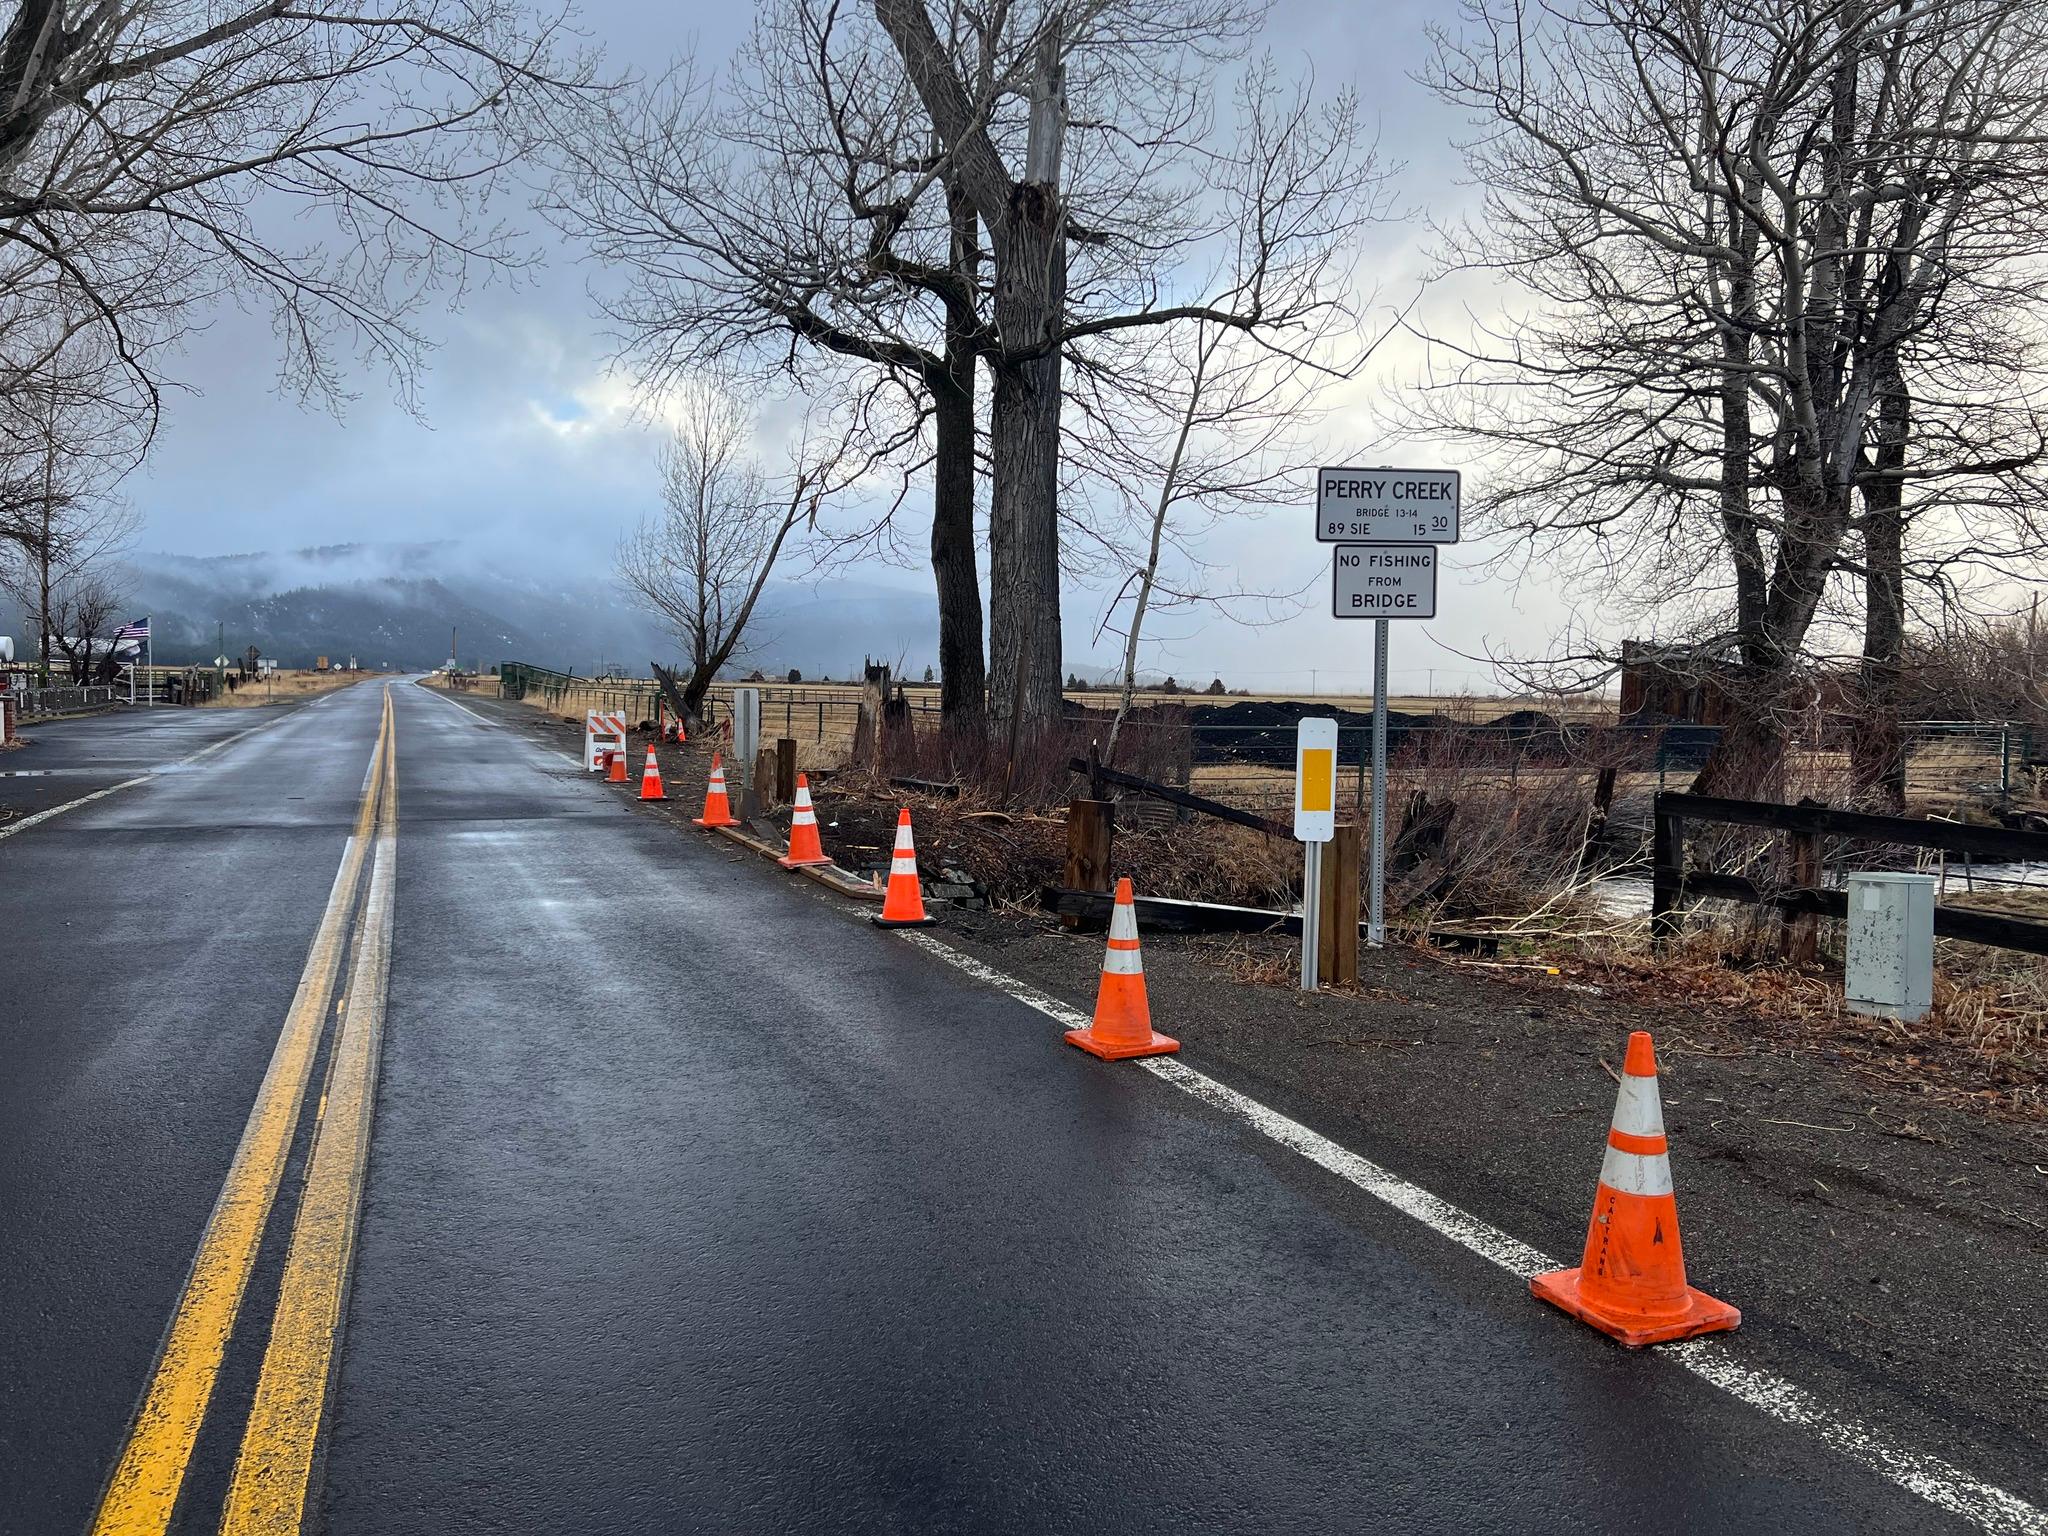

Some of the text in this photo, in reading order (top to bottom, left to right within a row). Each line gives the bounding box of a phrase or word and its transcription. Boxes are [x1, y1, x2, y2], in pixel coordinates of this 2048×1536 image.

[1325, 480, 1452, 501] PERRY CREEK
[1356, 508, 1418, 518] BRIDGE 13-14
[1328, 516, 1448, 536] 89 SIE 15 30
[1339, 555, 1431, 567] NO FISHING
[1368, 577, 1402, 587] FROM
[1352, 594, 1417, 608] BRIDGE
[1598, 1196, 1615, 1276] CALTRANS
